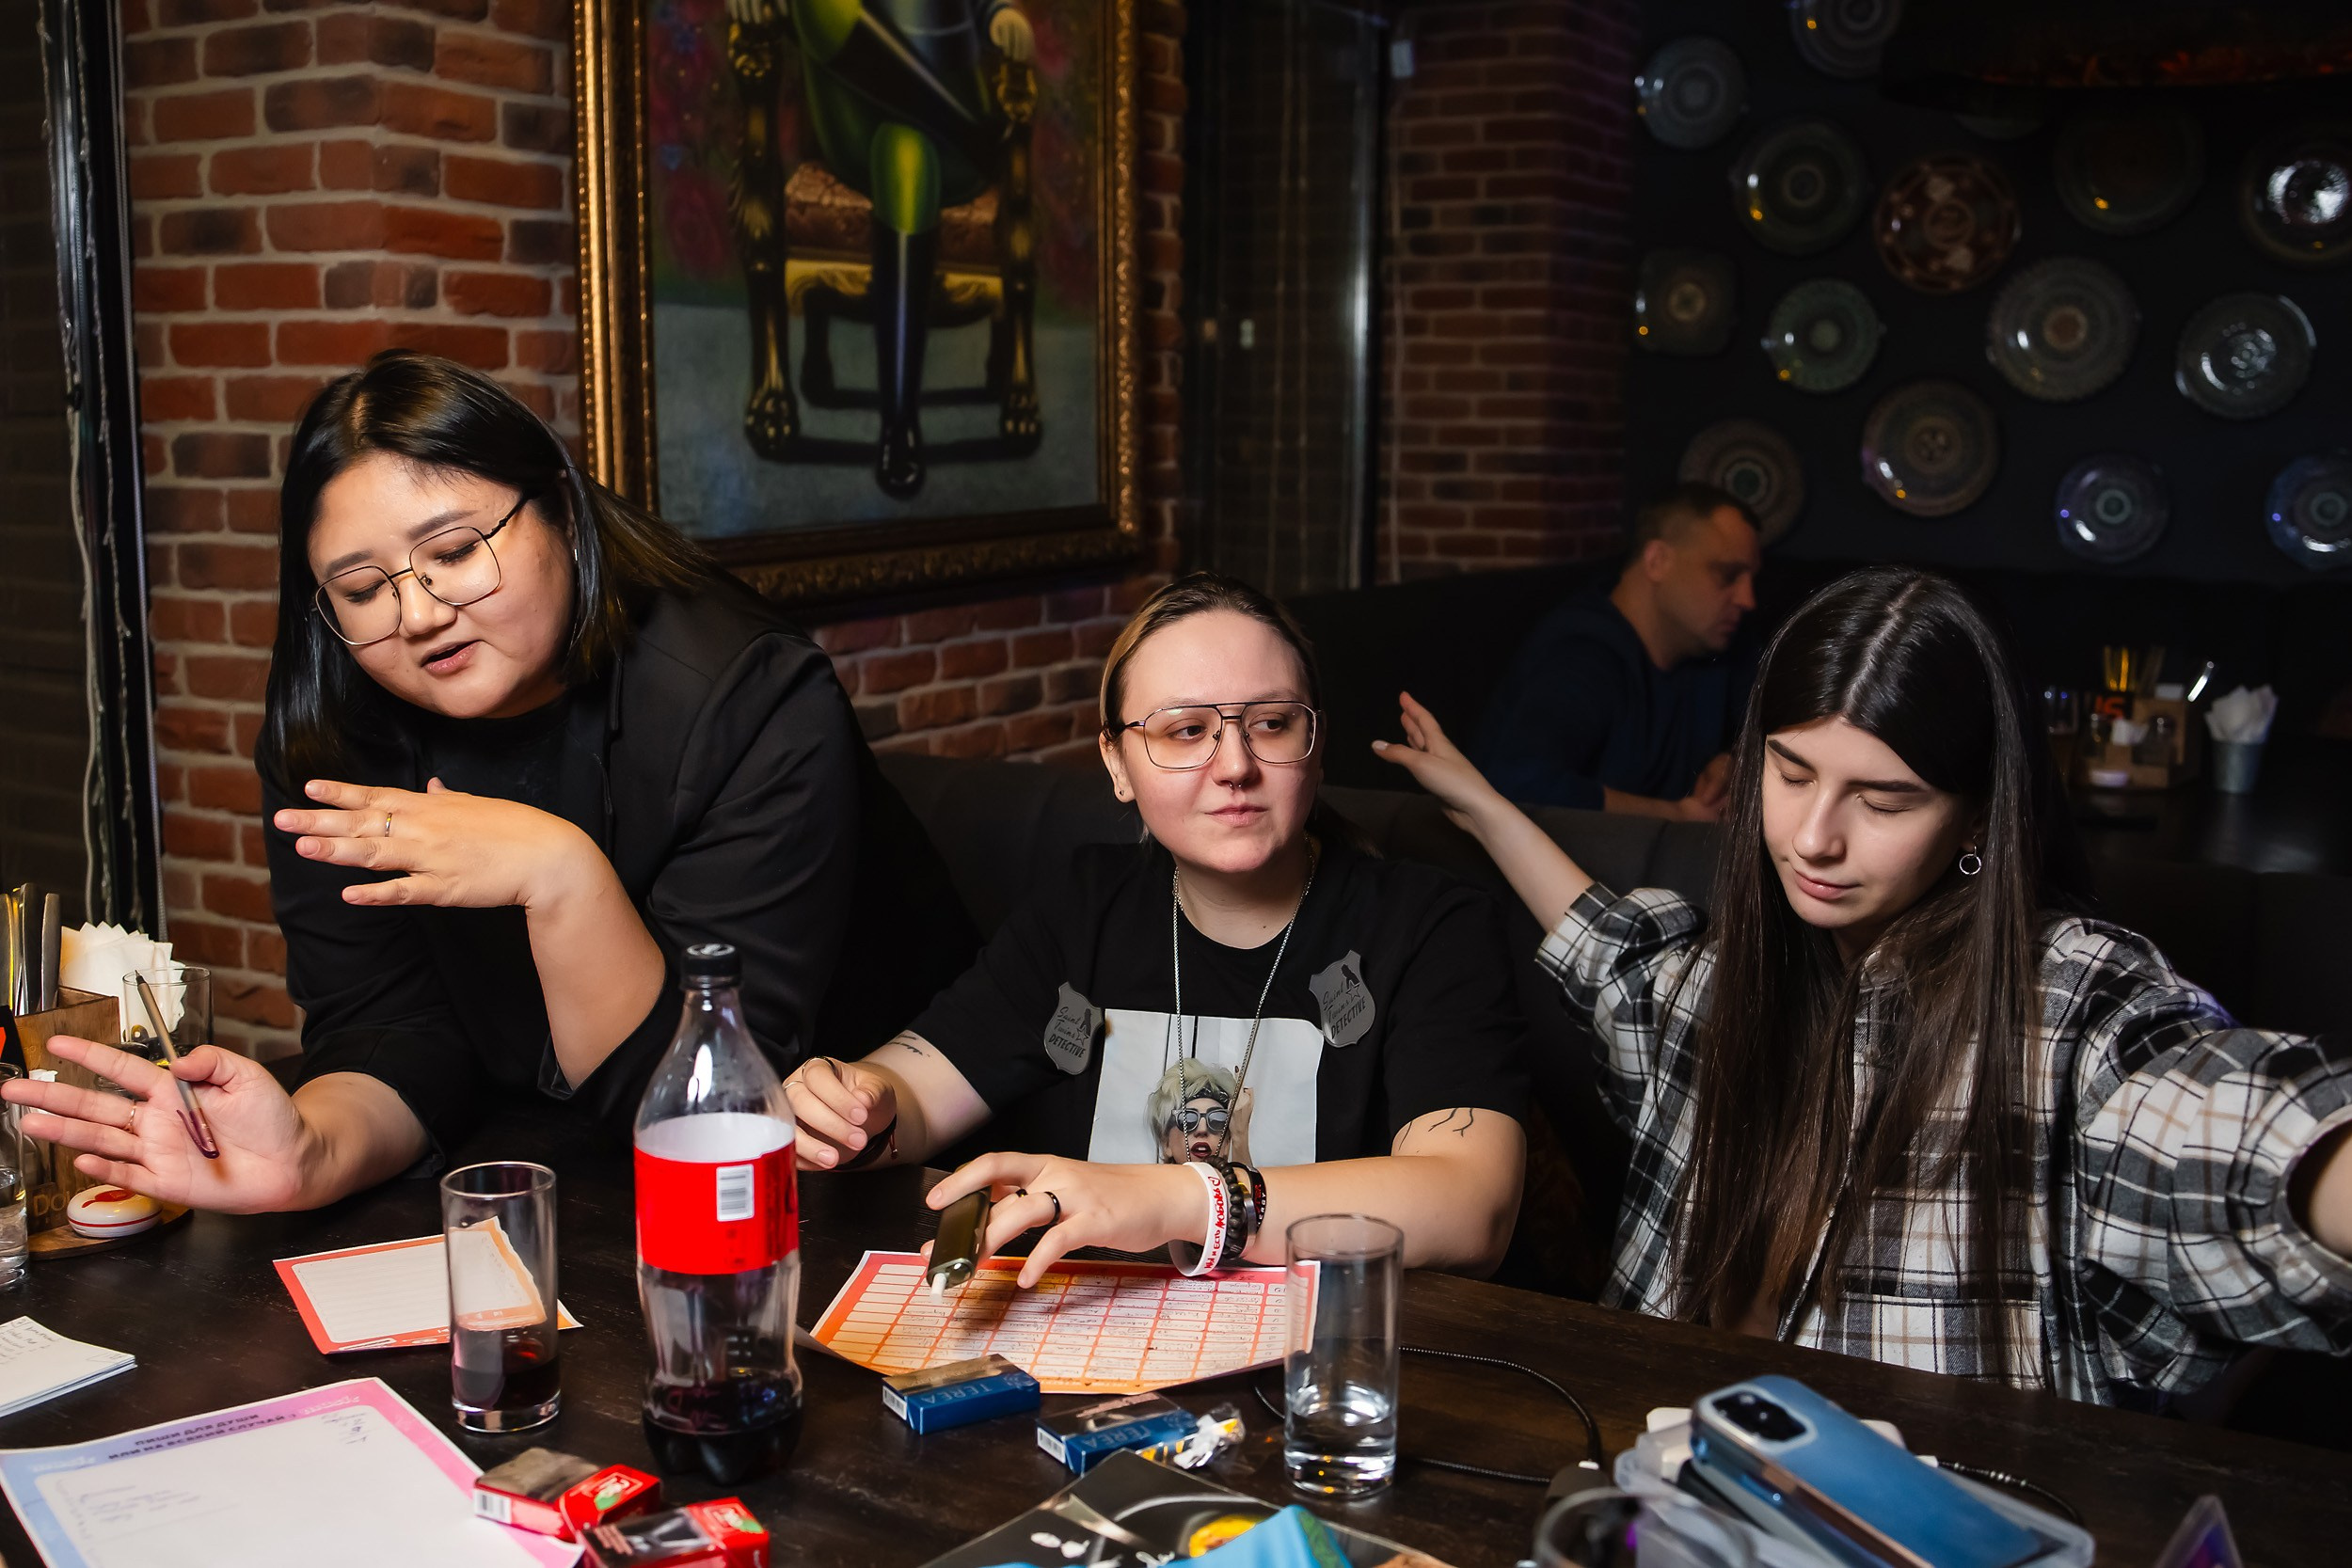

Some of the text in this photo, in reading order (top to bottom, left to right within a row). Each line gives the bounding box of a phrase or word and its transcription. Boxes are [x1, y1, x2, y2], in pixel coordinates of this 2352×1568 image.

[1057, 1006, 1082, 1025] Saint
[1331, 996, 1366, 1039] DETECTIVE
[1048, 1034, 1086, 1058] DETECTIVE
[920, 1384, 993, 1404] TEREA
[135, 1414, 260, 1446] ПИШИ ДЛЯ ДУШИ
[1081, 1425, 1152, 1449] TEREA
